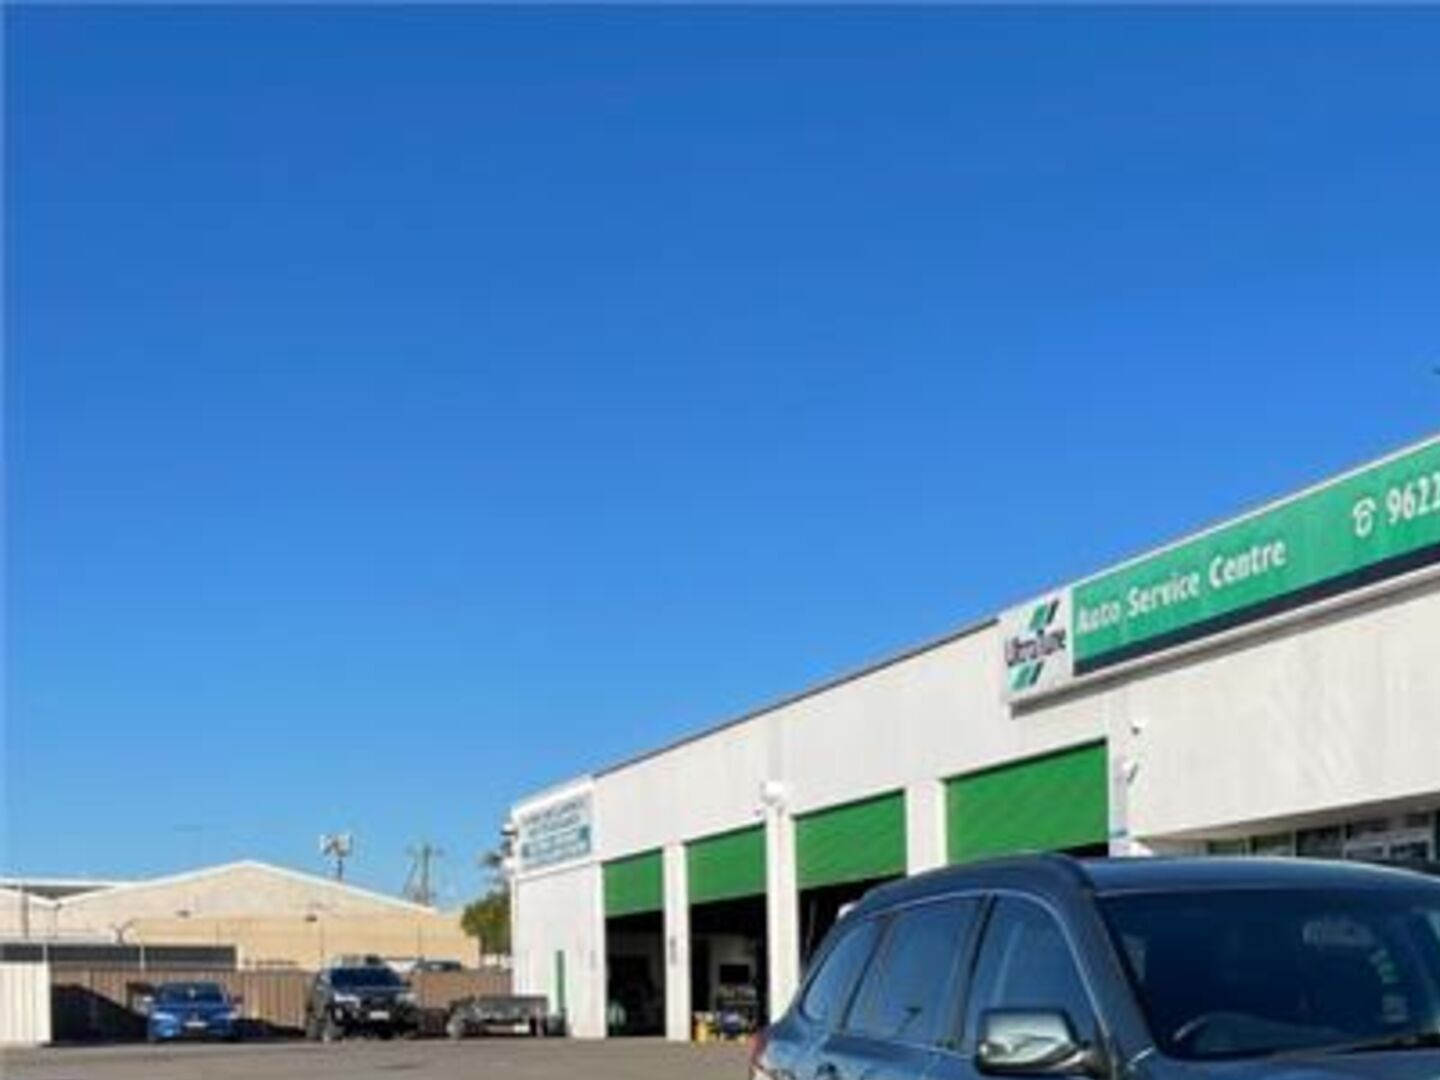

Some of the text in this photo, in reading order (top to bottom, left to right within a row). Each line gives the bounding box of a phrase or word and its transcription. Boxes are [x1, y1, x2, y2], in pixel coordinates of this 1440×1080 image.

[1077, 540, 1286, 635] Auto Service Centre
